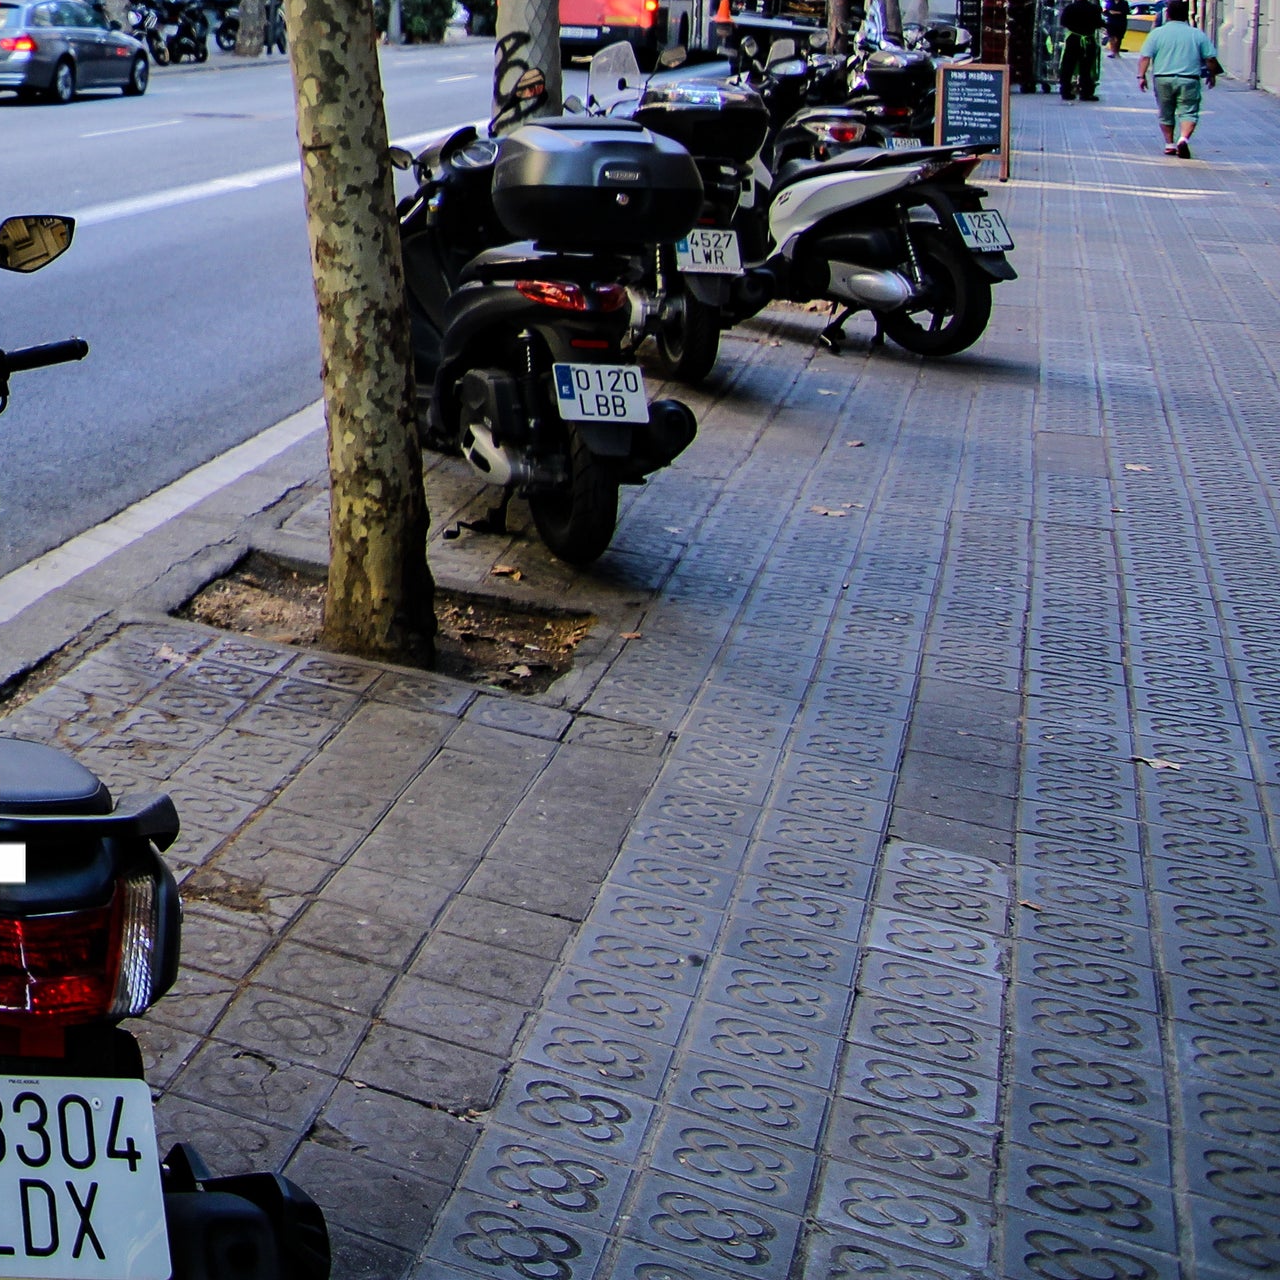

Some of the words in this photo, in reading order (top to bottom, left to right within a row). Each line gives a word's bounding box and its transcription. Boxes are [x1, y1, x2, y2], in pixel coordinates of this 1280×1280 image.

[968, 213, 1001, 229] 1251
[690, 232, 733, 249] 4527
[972, 229, 1000, 243] KJX
[691, 248, 725, 265] LWR
[562, 385, 570, 394] E
[575, 369, 639, 393] 0120
[579, 393, 627, 417] LBB
